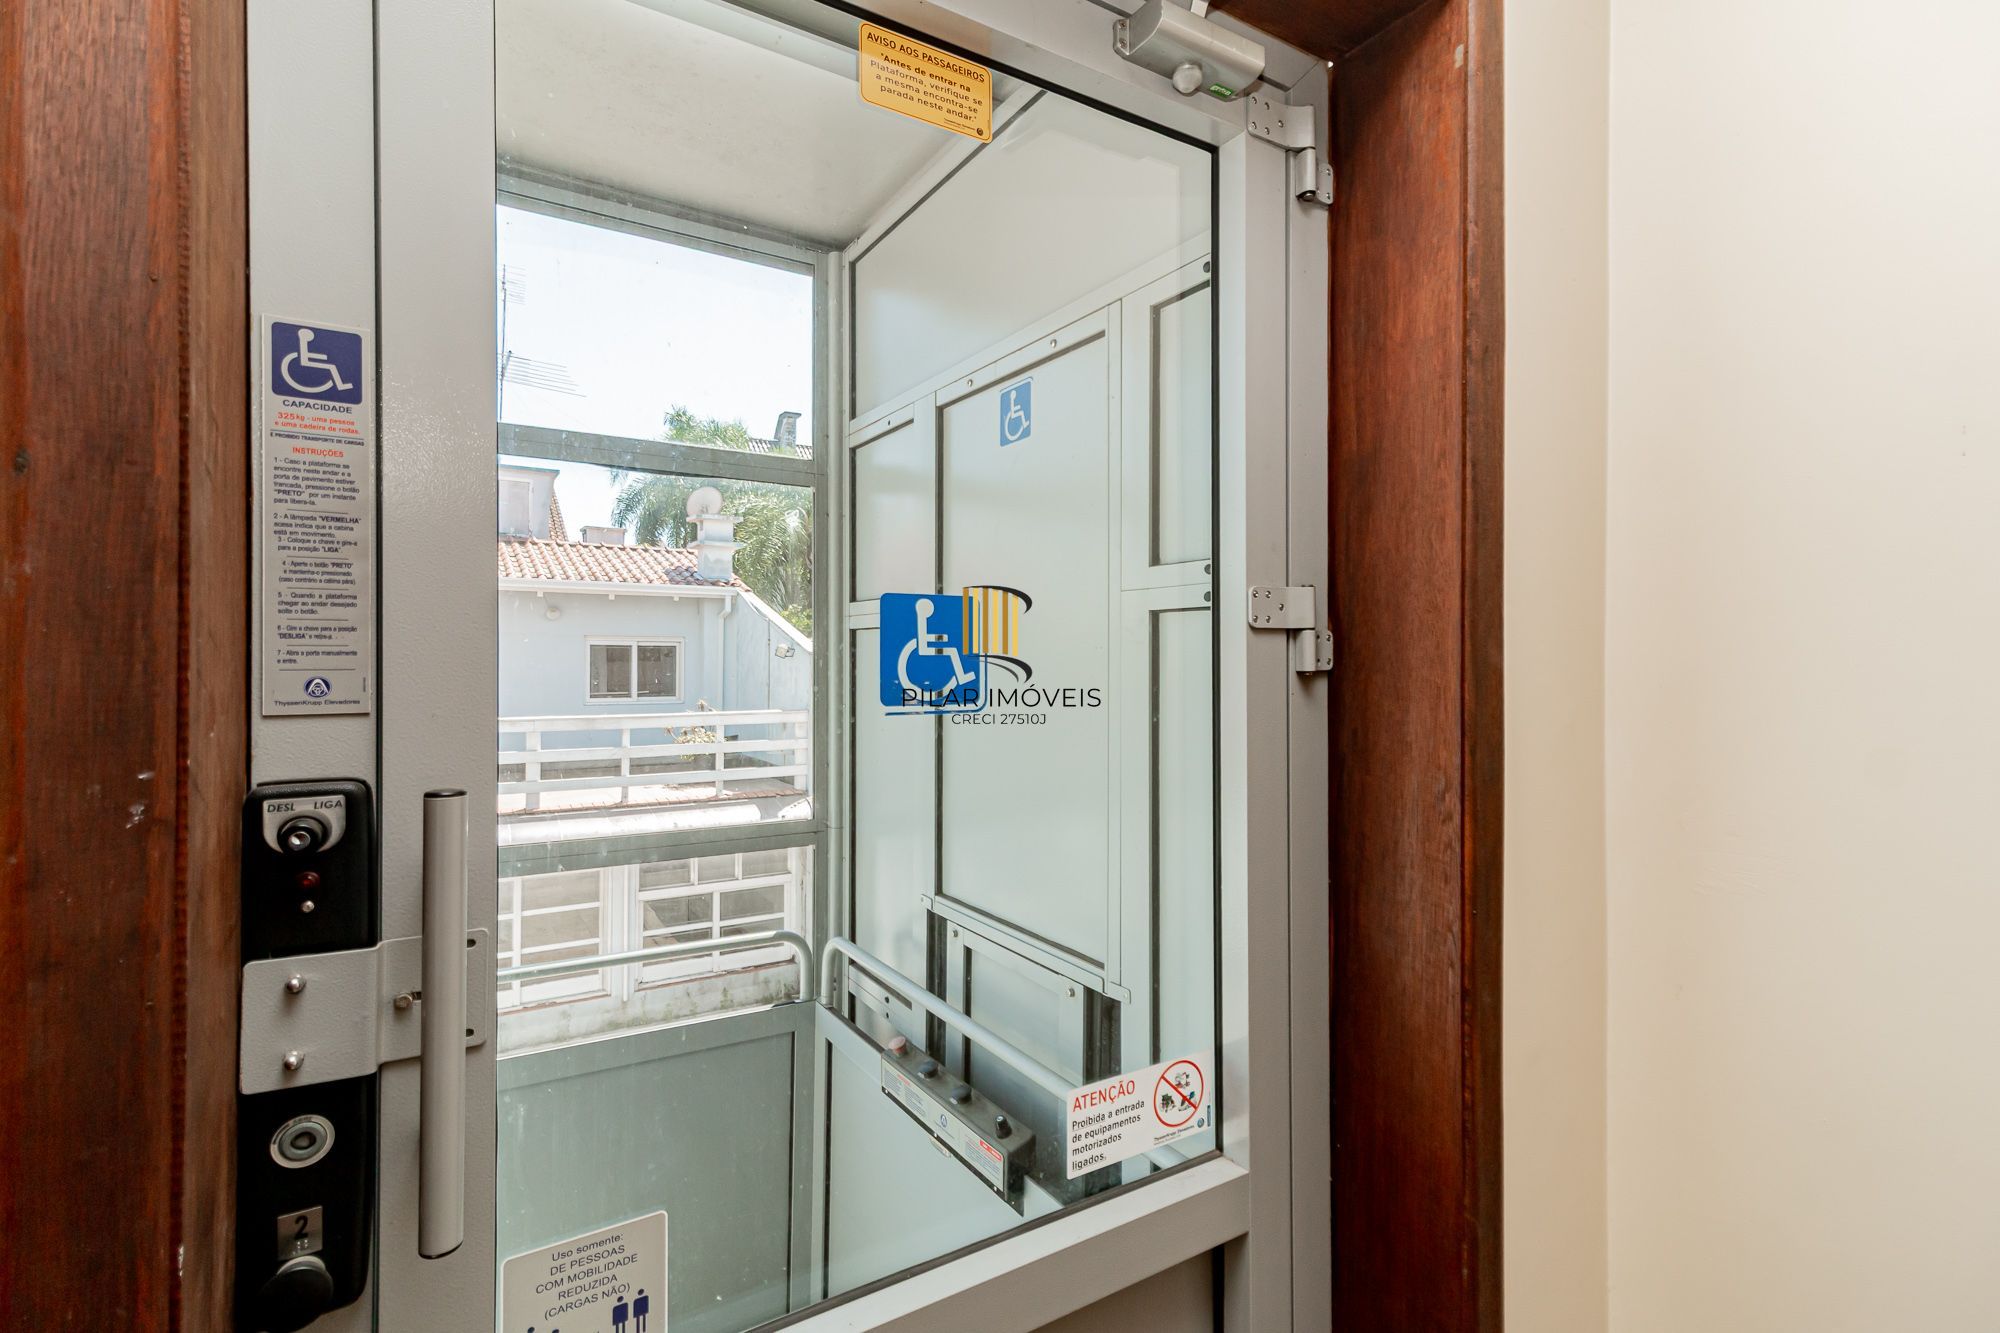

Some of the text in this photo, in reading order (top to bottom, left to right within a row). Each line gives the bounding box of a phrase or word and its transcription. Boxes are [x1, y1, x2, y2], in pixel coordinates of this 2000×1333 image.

[866, 31, 985, 83] AVISO AOS PASSAGEIROS
[914, 66, 926, 77] de
[929, 72, 957, 87] entrar
[959, 82, 971, 93] na
[880, 85, 914, 102] parada
[917, 97, 943, 112] neste
[884, 76, 920, 94] mesma
[923, 90, 979, 114] encontra-se
[929, 82, 970, 103] verifique
[972, 98, 983, 106] se
[282, 399, 353, 414] CAPACIDADE
[329, 418, 355, 426] pessoa
[292, 446, 344, 458] INSTRUÇÕES
[267, 802, 296, 813] DESL
[314, 799, 343, 810] LIGA
[1072, 1079, 1136, 1113] ATENÇÃO
[1072, 1115, 1106, 1131] Proibida
[1115, 1099, 1145, 1117] entrada
[1072, 1134, 1082, 1144] de
[1084, 1113, 1141, 1142] equipamentos
[1072, 1132, 1122, 1156] motorizados
[1072, 1152, 1107, 1171] ligados.
[294, 1215, 308, 1240] 2
[550, 1244, 625, 1276] DE PESSOAS
[551, 1233, 624, 1262] Uso somente:
[535, 1253, 638, 1294] COM MOBILIDADE
[558, 1274, 618, 1301] REDUZIDA
[544, 1282, 631, 1321] (CARGAS NÃO)
